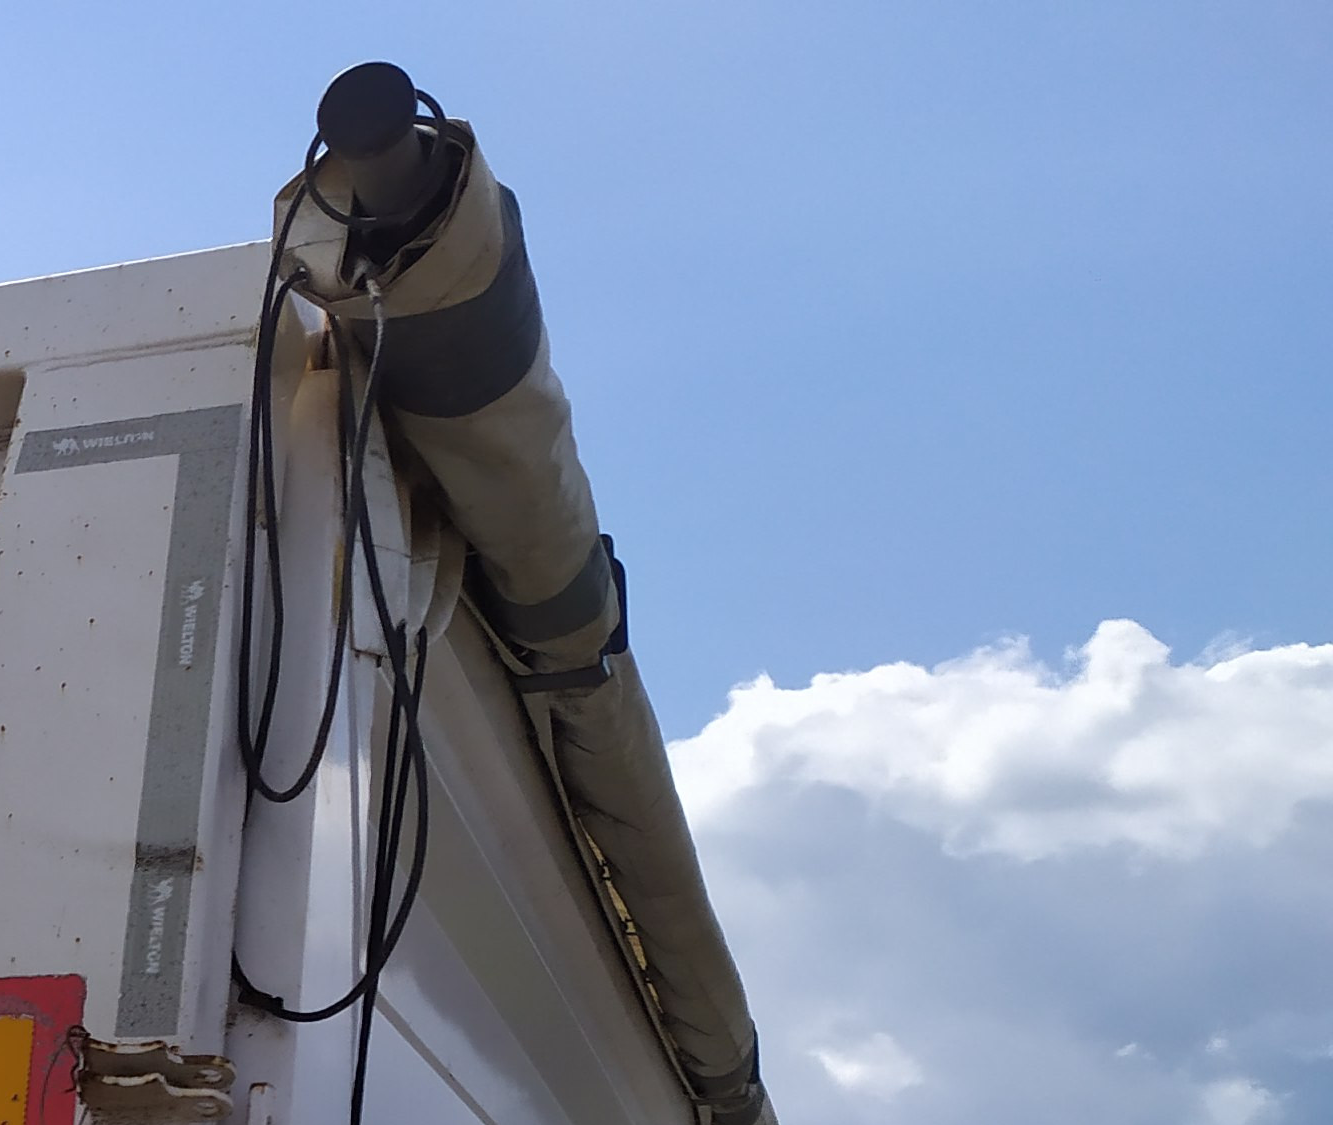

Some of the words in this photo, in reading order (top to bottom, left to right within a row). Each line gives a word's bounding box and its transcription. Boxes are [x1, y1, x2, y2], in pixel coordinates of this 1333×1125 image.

[83, 431, 155, 449] WIELTON
[179, 604, 198, 665] WIELTON
[146, 906, 166, 974] WIELTON
